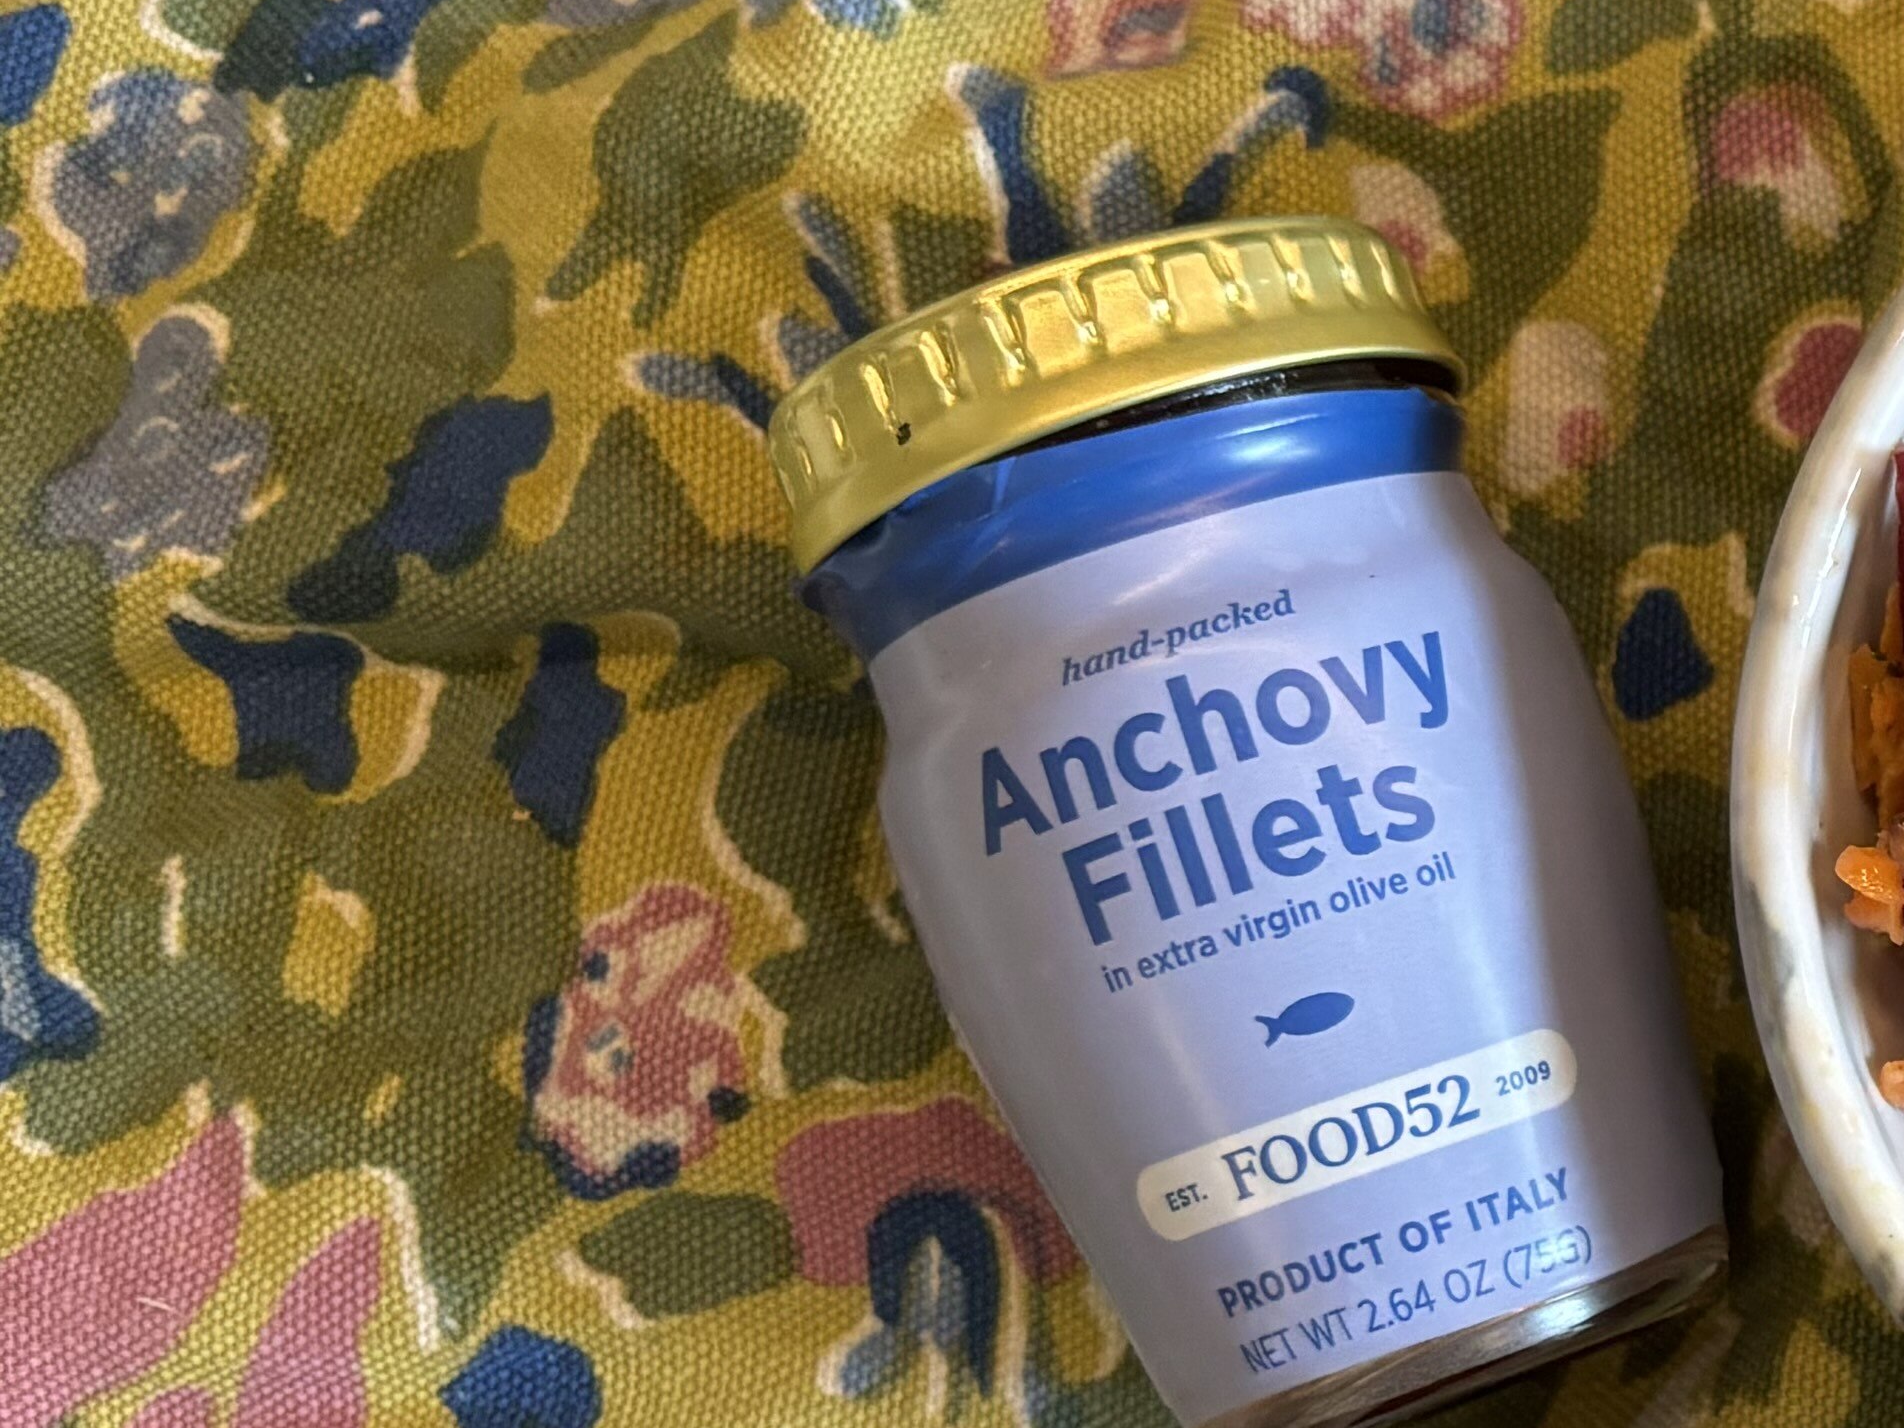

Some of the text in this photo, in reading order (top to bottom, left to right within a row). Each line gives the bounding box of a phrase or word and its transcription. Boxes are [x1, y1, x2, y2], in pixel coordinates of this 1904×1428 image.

[1061, 589, 1296, 687] hand-packed
[979, 630, 1454, 857] Anchovy
[1062, 763, 1436, 947] Fillets
[1103, 851, 1457, 993] in extra virgin olive oil
[1164, 1060, 1552, 1215] EST. FOOD52 2009
[1217, 1167, 1570, 1319] PRODUCT OF ITALY
[1239, 1223, 1593, 1374] NET WT 2.64 OZ (75G)
